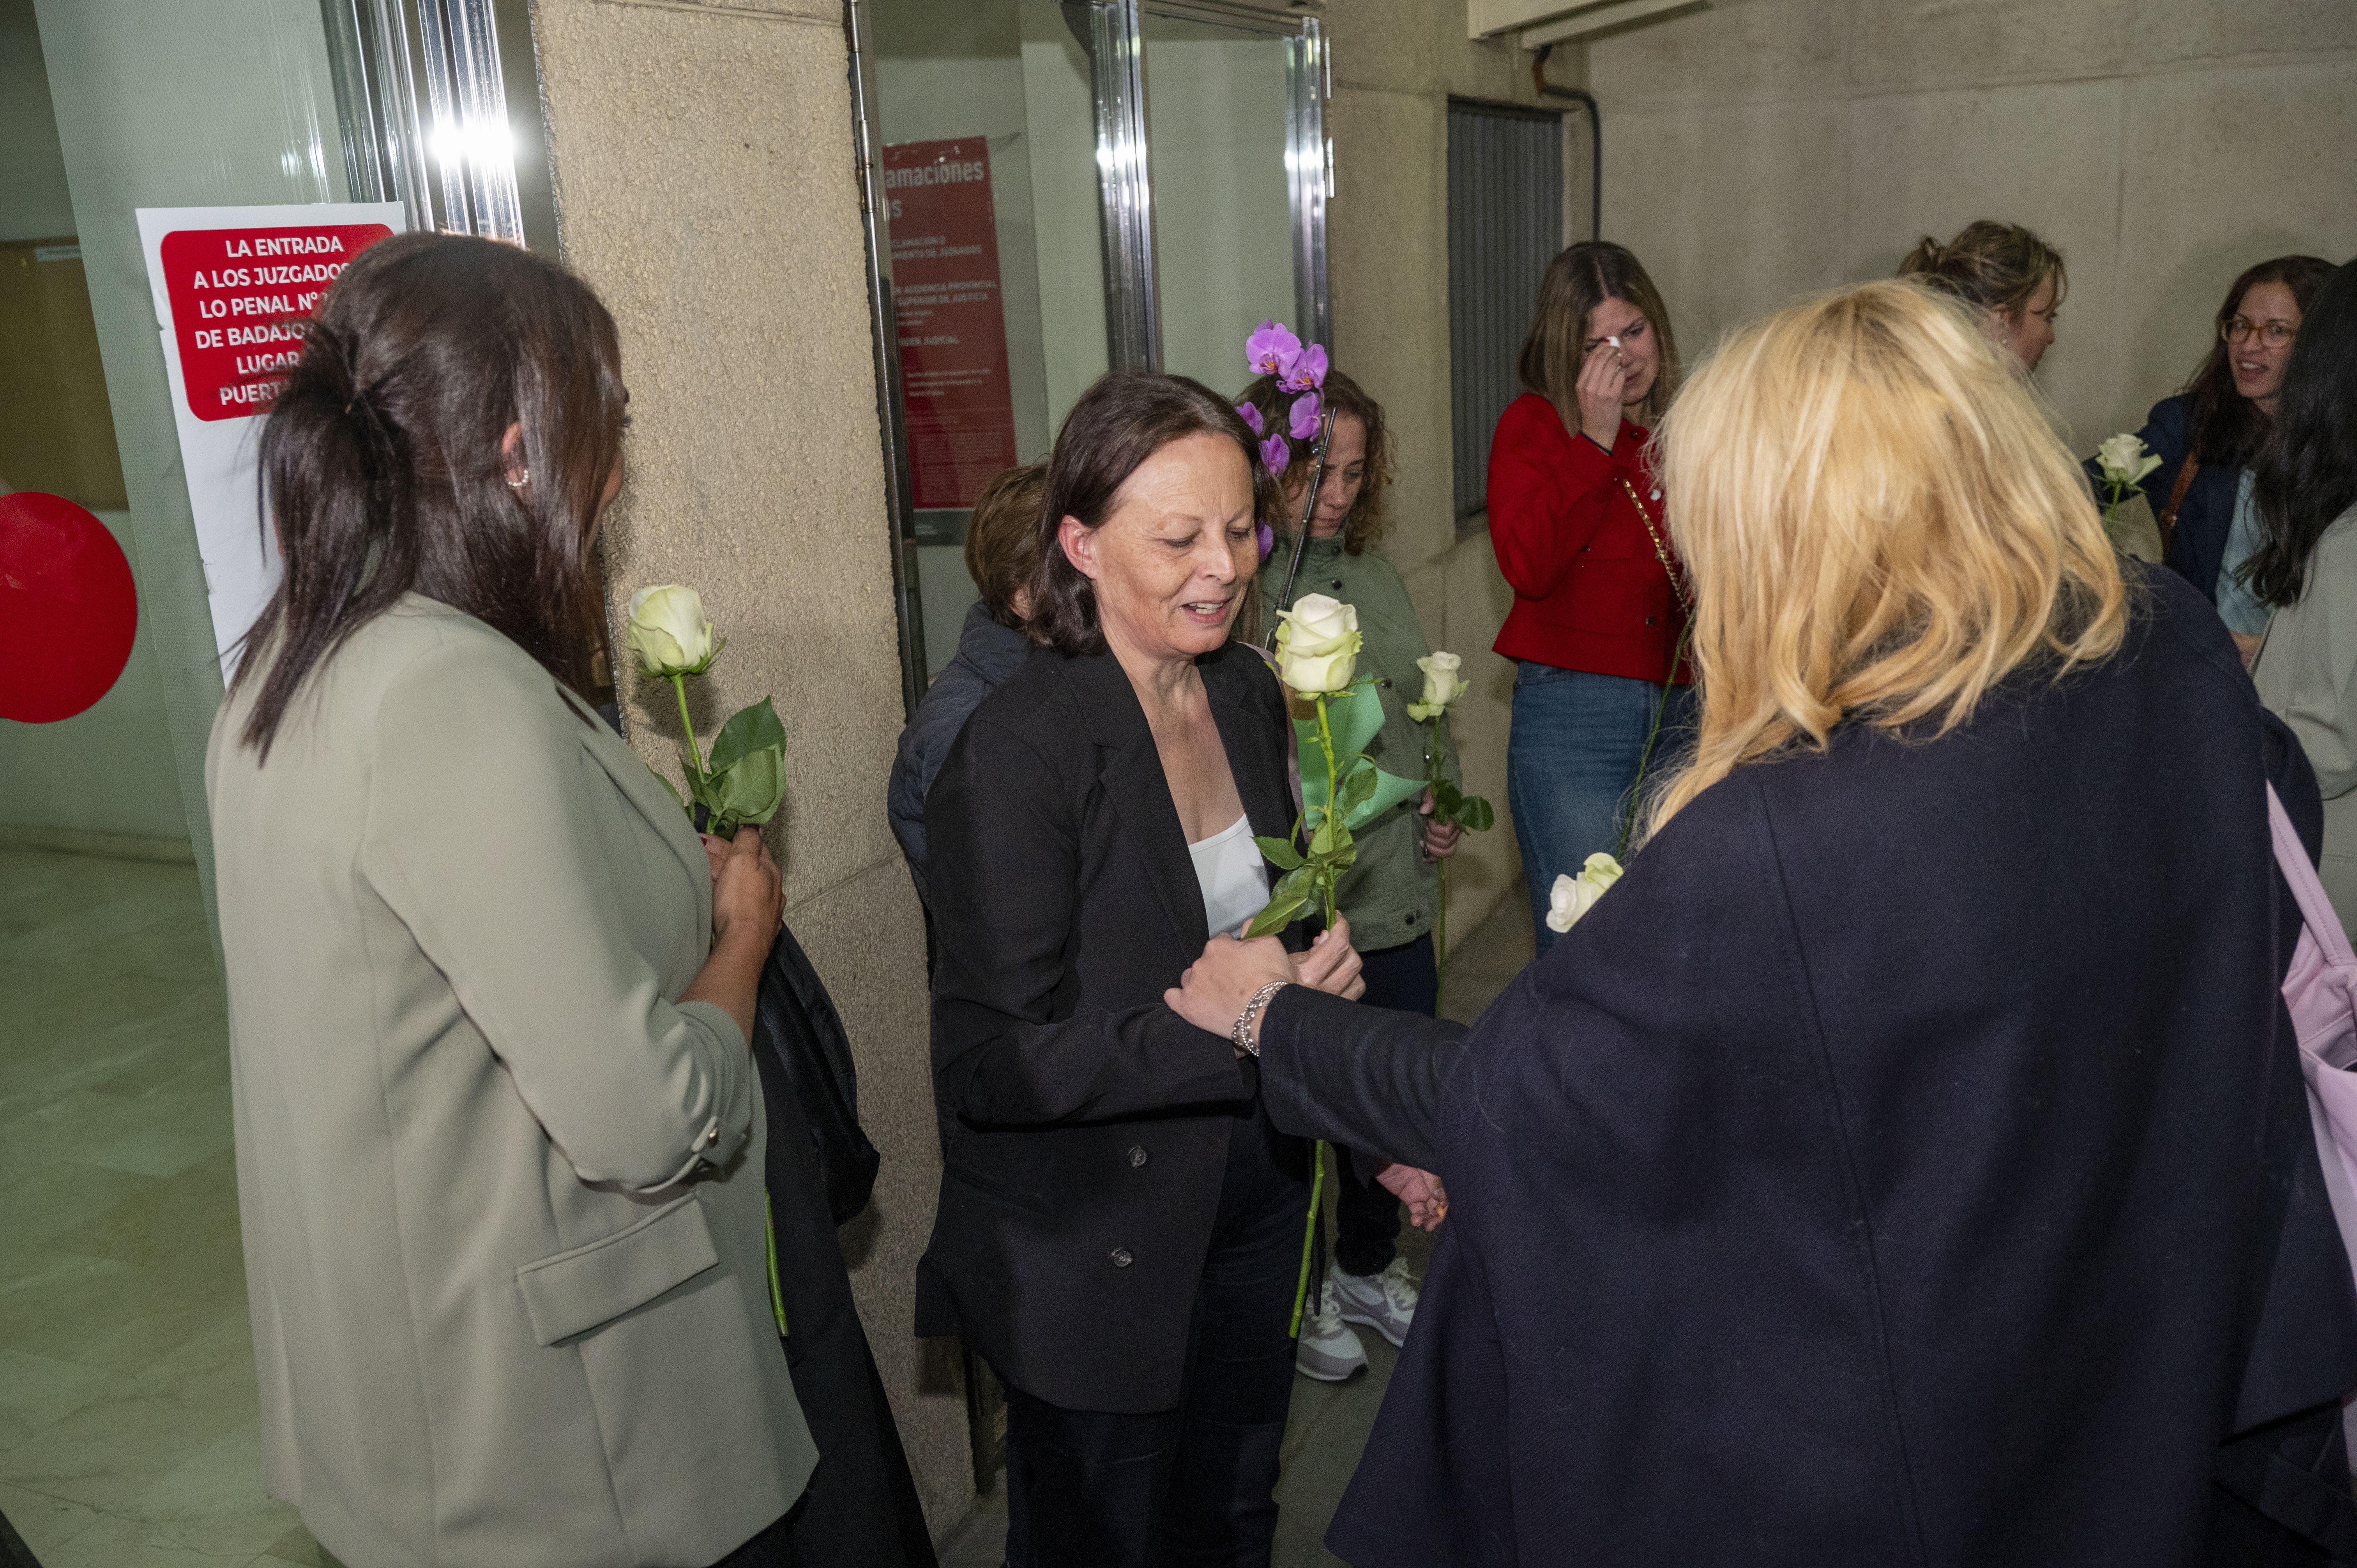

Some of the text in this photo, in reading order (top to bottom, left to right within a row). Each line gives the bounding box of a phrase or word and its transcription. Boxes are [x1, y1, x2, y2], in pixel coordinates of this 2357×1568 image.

[885, 159, 985, 189] amaciones
[891, 199, 903, 218] s
[225, 236, 344, 258] LA ENTRADA
[194, 271, 209, 289] A
[212, 268, 251, 288] LOS
[199, 299, 227, 319] LO
[231, 295, 295, 316] PENAL
[195, 323, 313, 349] DE BADAJO
[236, 351, 300, 374] LUGAR
[219, 380, 291, 405] PUERT
